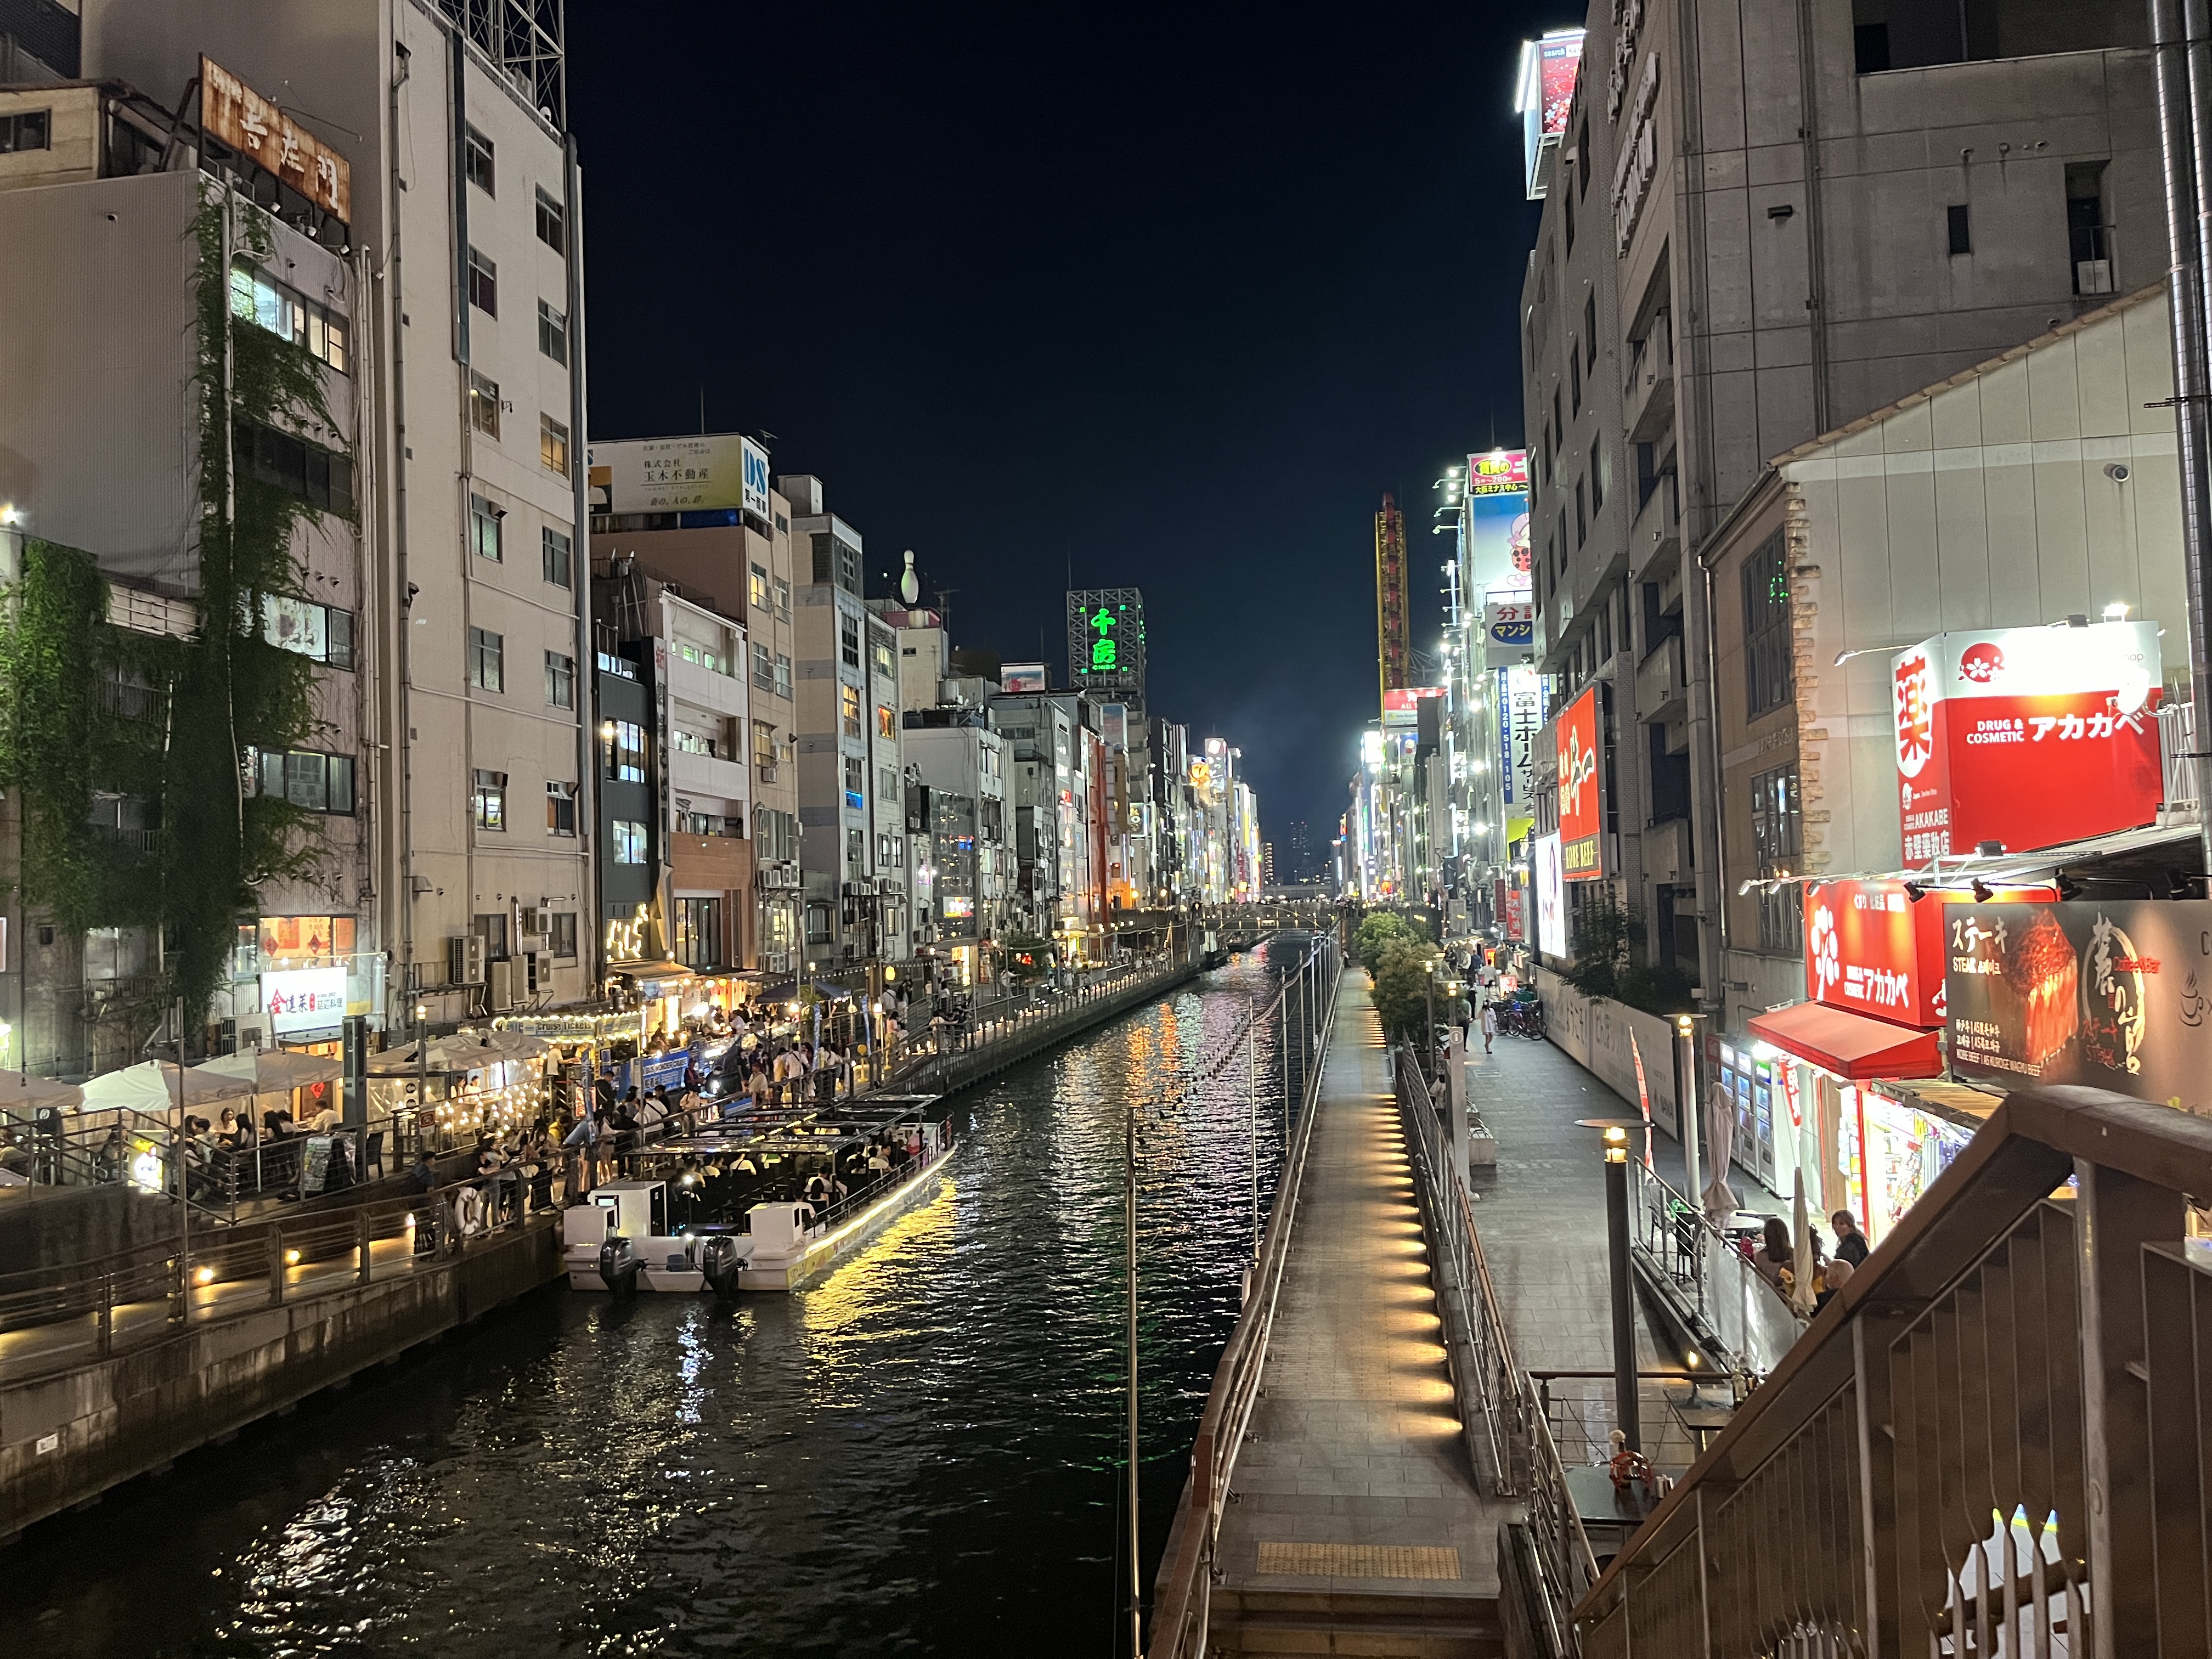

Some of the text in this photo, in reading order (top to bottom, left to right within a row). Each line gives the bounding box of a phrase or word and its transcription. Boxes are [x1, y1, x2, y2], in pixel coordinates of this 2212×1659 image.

[1544, 47, 1565, 57] search
[644, 459, 681, 469] 株式会社
[644, 467, 710, 482] 玉木不動産
[744, 447, 766, 495] DS
[1091, 608, 1116, 664] 千房
[1895, 655, 1931, 763] 薬
[1977, 718, 2024, 731] DRUG &
[2028, 712, 2145, 742] アカカベ
[1966, 731, 2025, 744] COSMETIC
[1915, 808, 1949, 829] AKAKABE
[1566, 840, 1594, 869] KOBE BEEF
[1952, 916, 2008, 954] ステーキ
[1953, 956, 1977, 974] STEAK
[1863, 967, 1909, 1009] アカカベ
[535, 1021, 561, 1031] Cruise
[562, 1020, 592, 1031] Tickets
[1968, 1051, 1980, 1064] BEEF
[2028, 1063, 2041, 1077] BEEF
